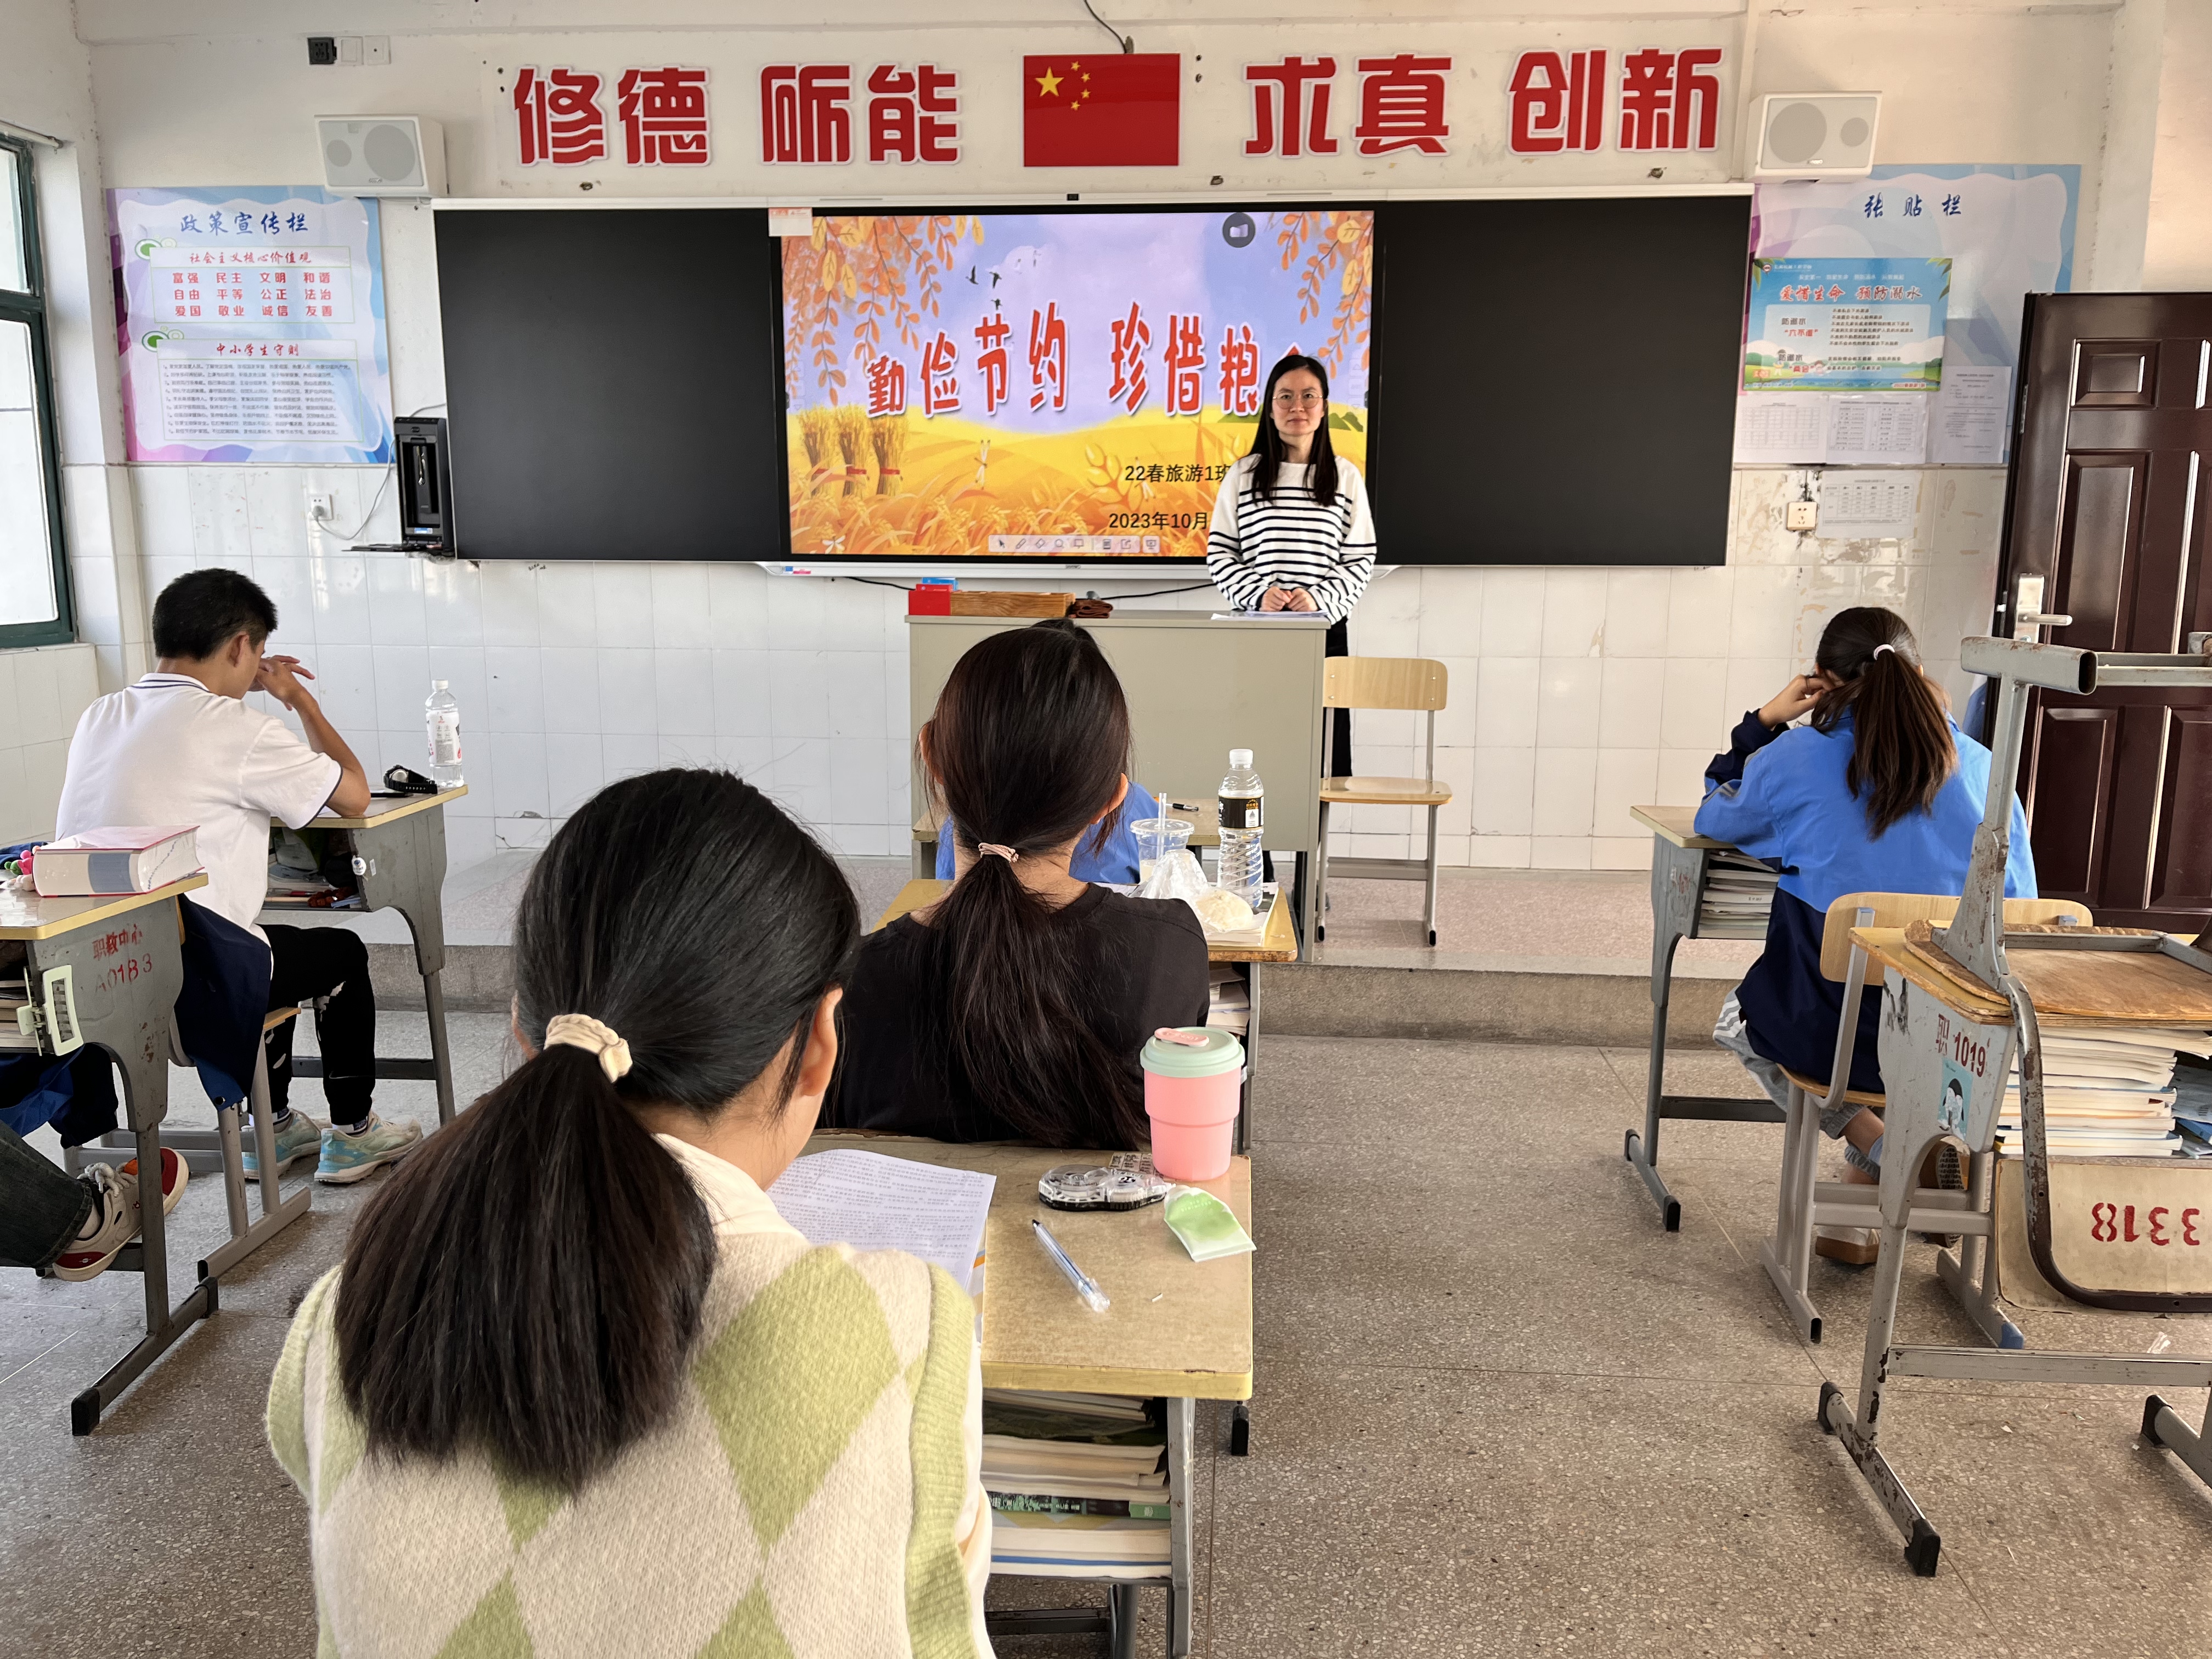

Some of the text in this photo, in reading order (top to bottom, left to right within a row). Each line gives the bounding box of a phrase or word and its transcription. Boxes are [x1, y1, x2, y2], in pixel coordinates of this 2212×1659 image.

[514, 67, 708, 165] 修德
[1245, 54, 1453, 156] 求真
[1510, 48, 1723, 153] 创新
[180, 211, 309, 235] 政策宣传栏
[189, 252, 312, 264] 社会主义核心价值观
[172, 272, 330, 284] 富强 民主 文明 和谐
[174, 289, 332, 300] 自由 平等 公正 法治
[1780, 285, 1922, 301] 爱惜生命 预防溺水
[175, 306, 332, 317] 爱国 敬业 诚信 友善
[216, 342, 300, 357] 中小学生守则
[860, 302, 1301, 415] 勤俭节约 珍惜粮
[1125, 464, 1231, 483] 22春旅游1班
[1109, 511, 1208, 531] 2023年10月
[1954, 1031, 1987, 1077] 1019
[2091, 1202, 2201, 1246] 3318
